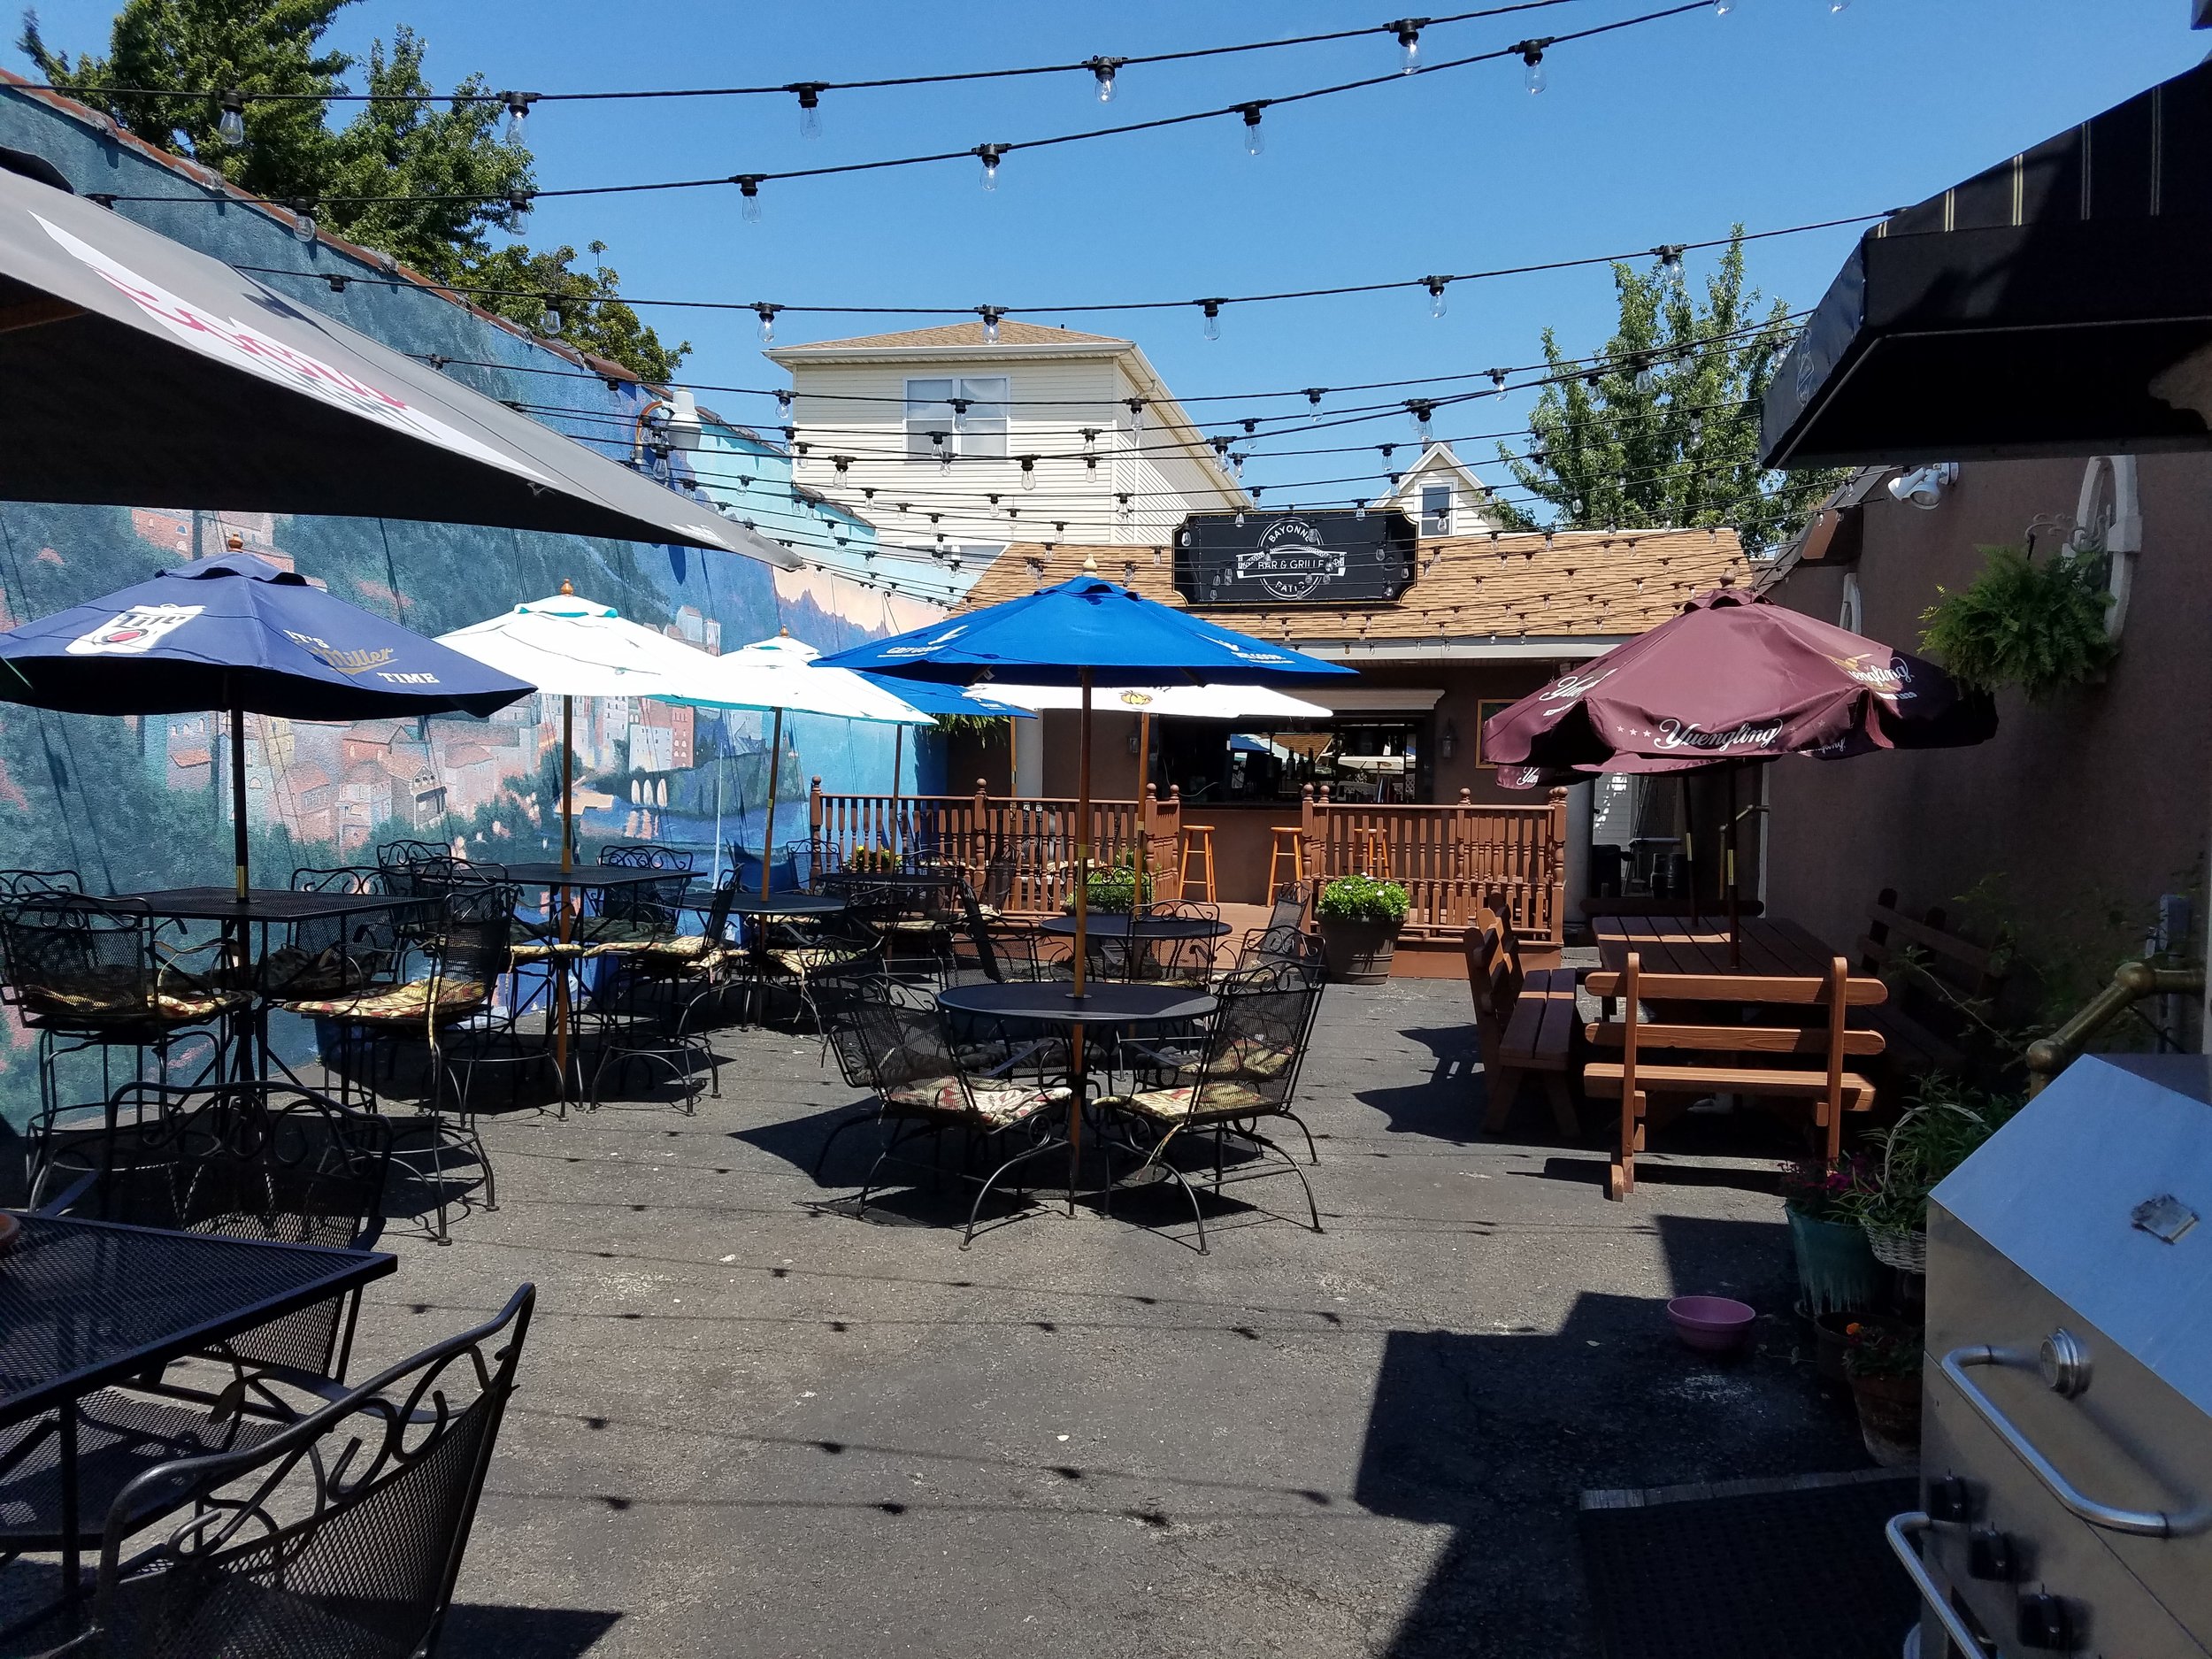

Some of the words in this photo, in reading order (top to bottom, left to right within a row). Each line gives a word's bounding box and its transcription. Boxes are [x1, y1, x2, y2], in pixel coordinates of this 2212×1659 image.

[88, 262, 410, 411] Coors
[229, 343, 443, 441] LIGHT
[1257, 560, 1277, 569] BAR
[1279, 560, 1286, 569] &
[111, 614, 187, 629] Lite
[282, 629, 331, 649] IT'S
[307, 648, 395, 669] Miller
[376, 672, 441, 684] TIME
[1653, 718, 1785, 752] Yuengling
